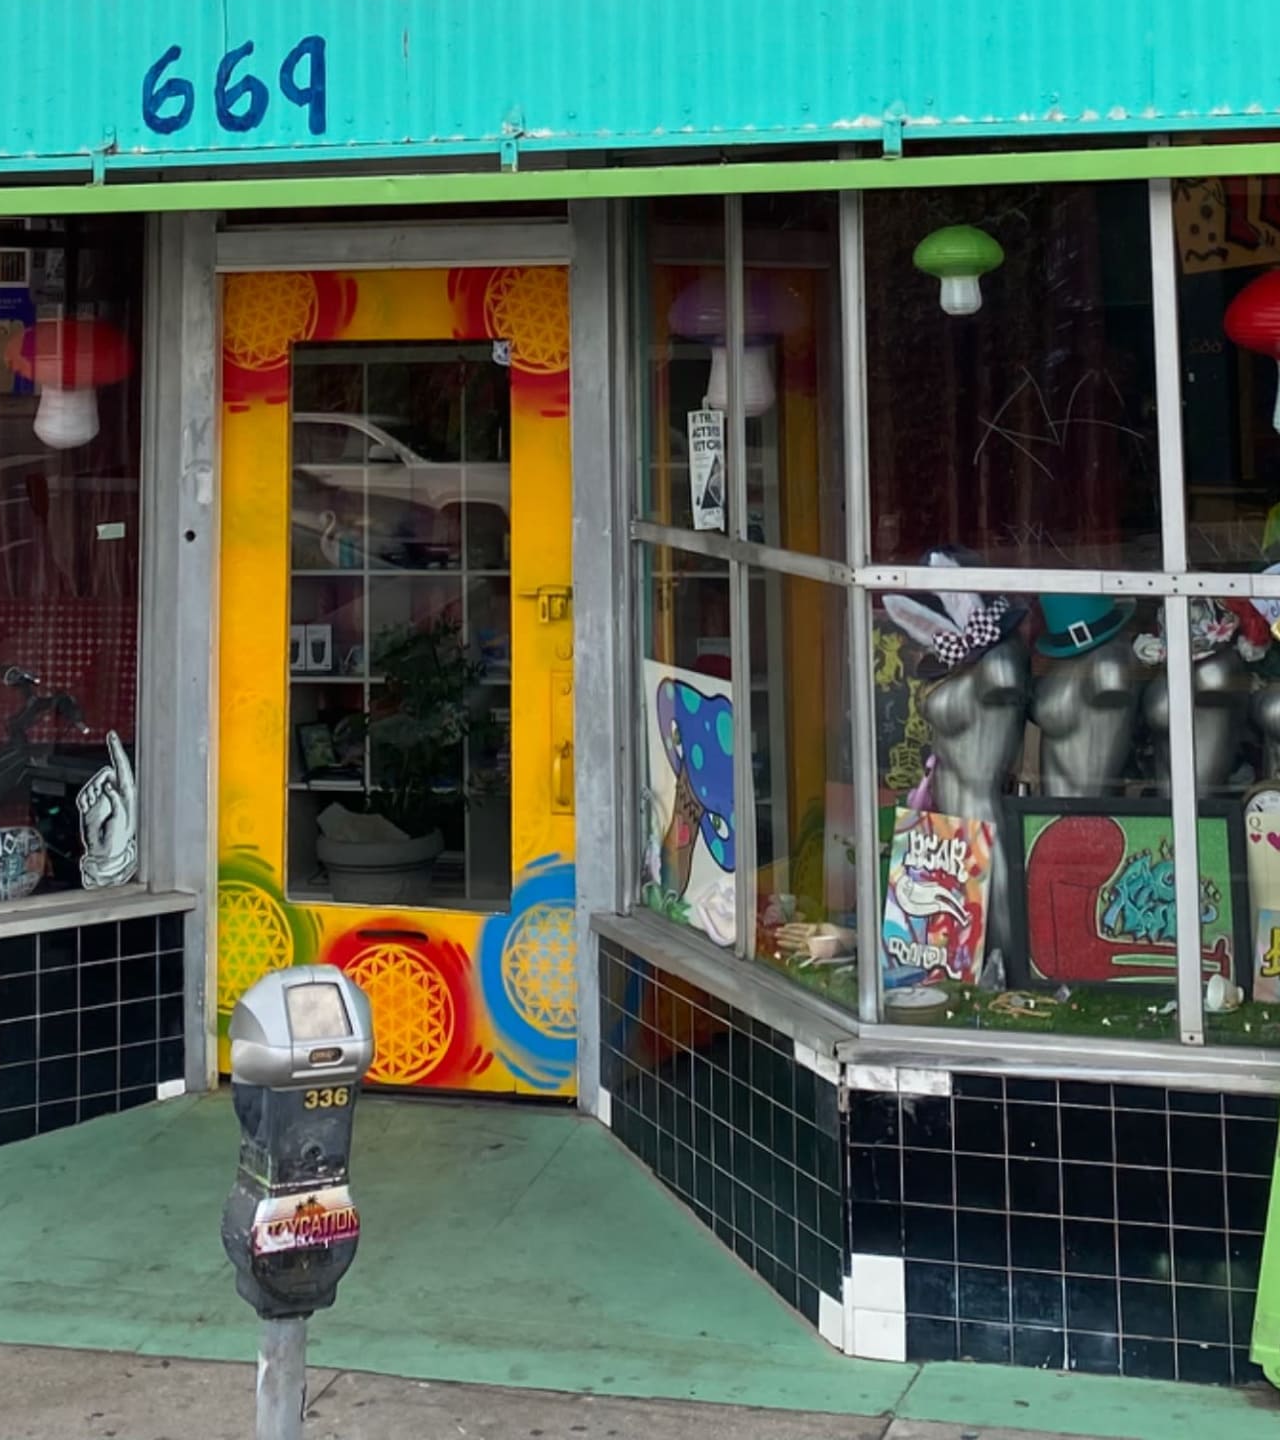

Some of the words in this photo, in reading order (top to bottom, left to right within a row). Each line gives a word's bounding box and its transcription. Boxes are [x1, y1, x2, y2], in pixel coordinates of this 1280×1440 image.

[141, 35, 327, 136] 669
[1249, 816, 1263, 832] Q
[304, 1087, 349, 1109] 336
